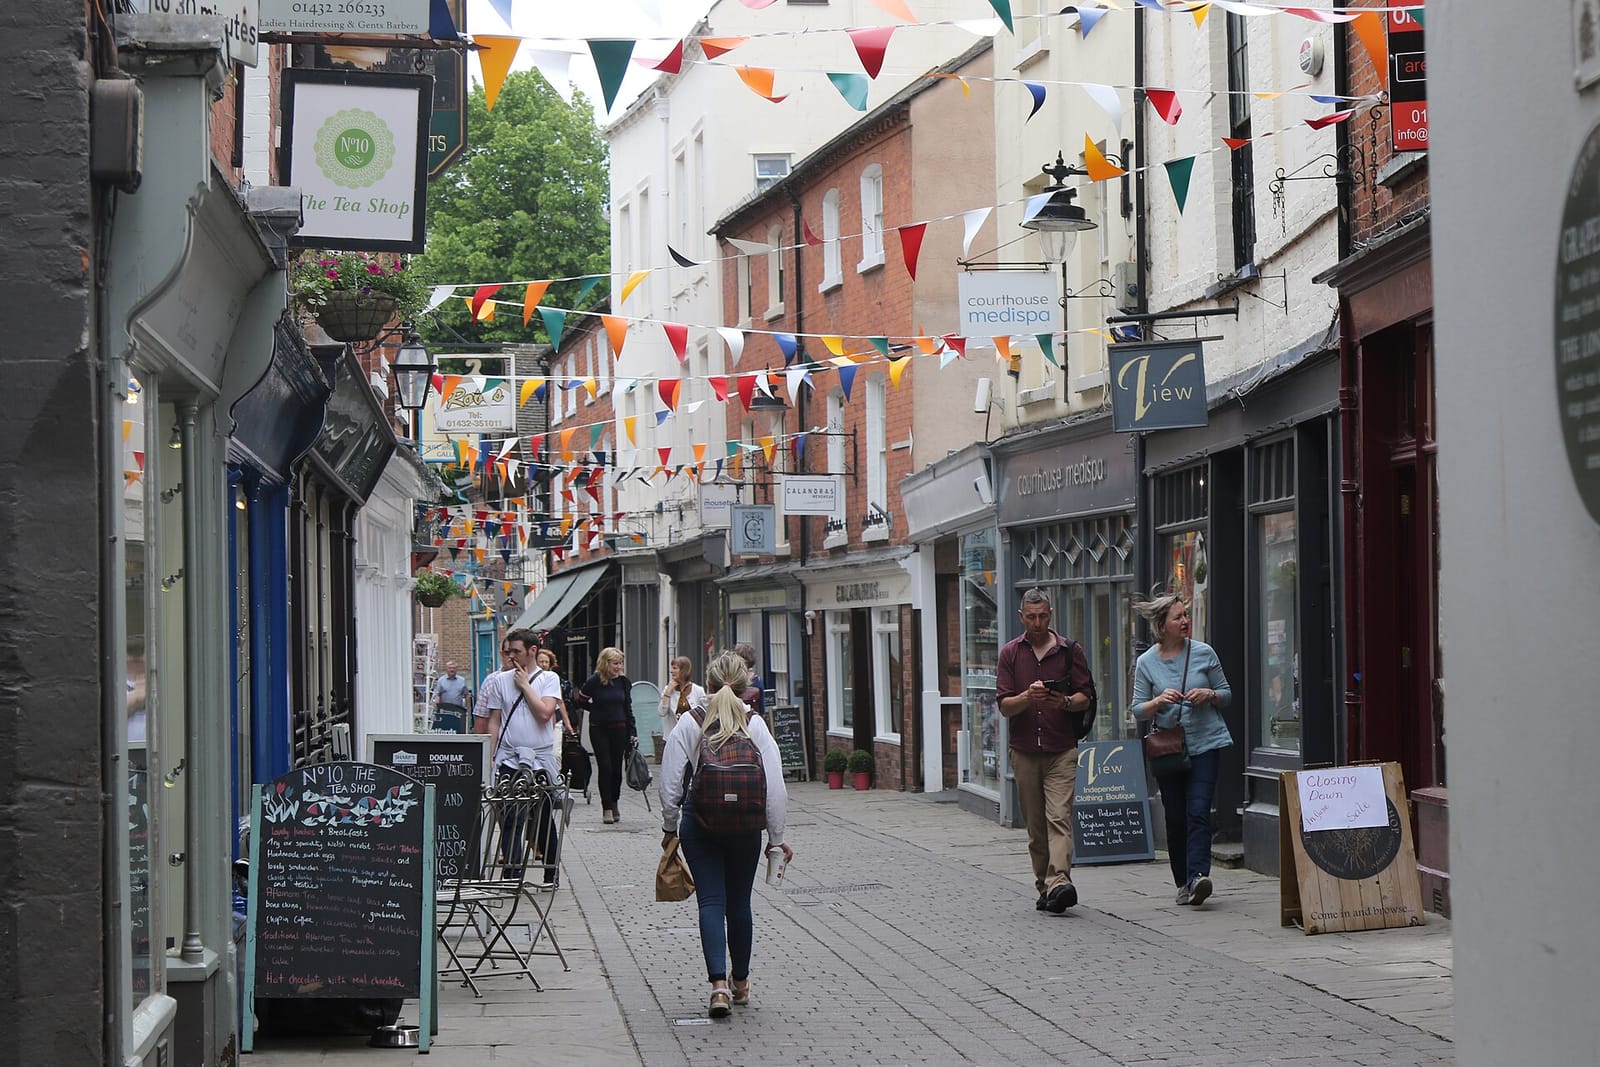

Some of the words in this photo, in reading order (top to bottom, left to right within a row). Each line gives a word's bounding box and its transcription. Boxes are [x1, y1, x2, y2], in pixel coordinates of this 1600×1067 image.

[292, 3, 333, 17] 01432
[338, 0, 385, 18] 266233
[259, 19, 286, 27] Ladies
[289, 20, 344, 30] Hairdressing
[347, 21, 354, 29] &
[358, 21, 383, 30] Gents
[386, 22, 418, 31] Barbers
[1397, 128, 1428, 141] info@
[333, 196, 361, 212] Tea
[367, 198, 409, 219] Shop
[968, 294, 1049, 307] courthouse
[968, 307, 1051, 326] medispa
[1117, 352, 1196, 422] View
[1017, 466, 1062, 496] courthouse
[1065, 455, 1104, 489] medispa
[787, 487, 834, 495] CALANDRAS
[1077, 745, 1124, 785] View
[352, 766, 377, 782] THE
[326, 784, 349, 794] TEA
[351, 783, 377, 794] SHOP
[1083, 785, 1126, 794] Independent
[1306, 775, 1357, 791] Closing
[444, 793, 463, 807] AND
[1075, 795, 1103, 803] Clothing
[1106, 793, 1136, 801] Boutique
[1309, 790, 1344, 801] Down
[1077, 811, 1095, 821] New
[1310, 910, 1338, 921] Come
[1340, 910, 1351, 919] in
[1352, 906, 1375, 918] and
